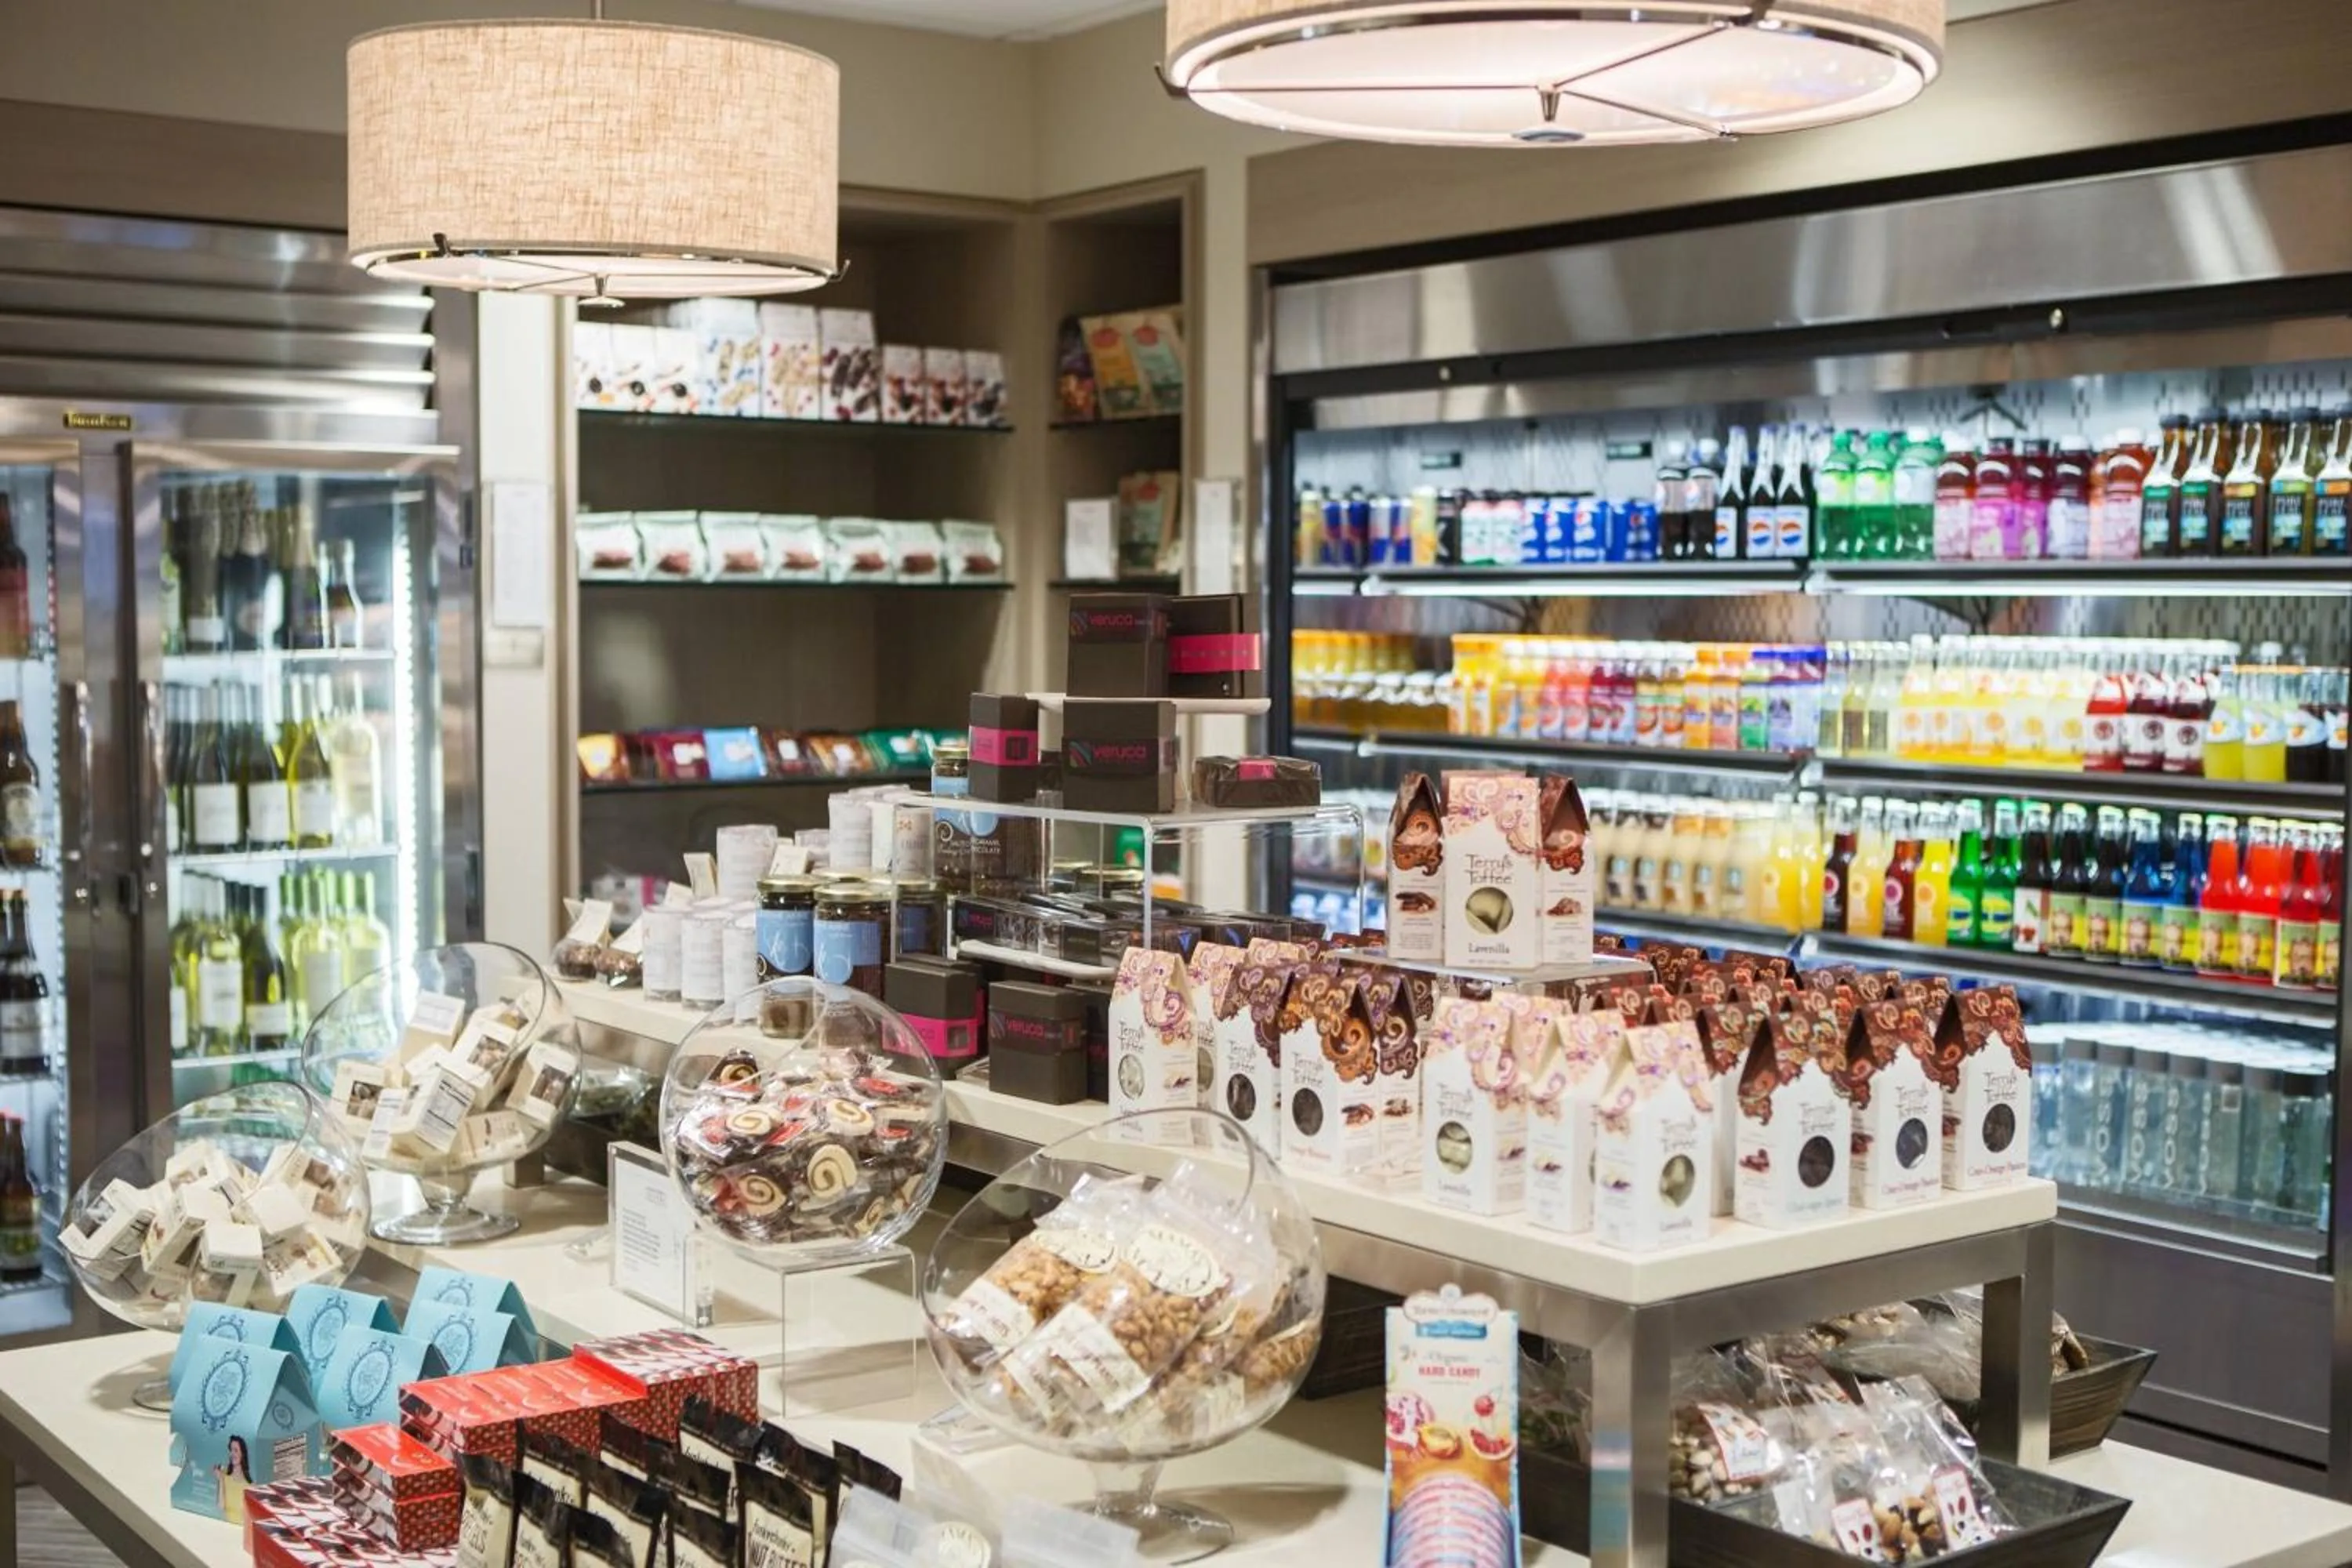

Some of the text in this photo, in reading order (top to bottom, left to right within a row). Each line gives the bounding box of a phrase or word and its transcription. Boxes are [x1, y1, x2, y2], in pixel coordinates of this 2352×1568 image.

[1089, 613, 1134, 626] veruca
[1094, 744, 1145, 760] veruca
[1465, 854, 1513, 872] Terry's
[1465, 868, 1512, 885] Toffee
[1419, 1367, 1480, 1380] HARD CANDY
